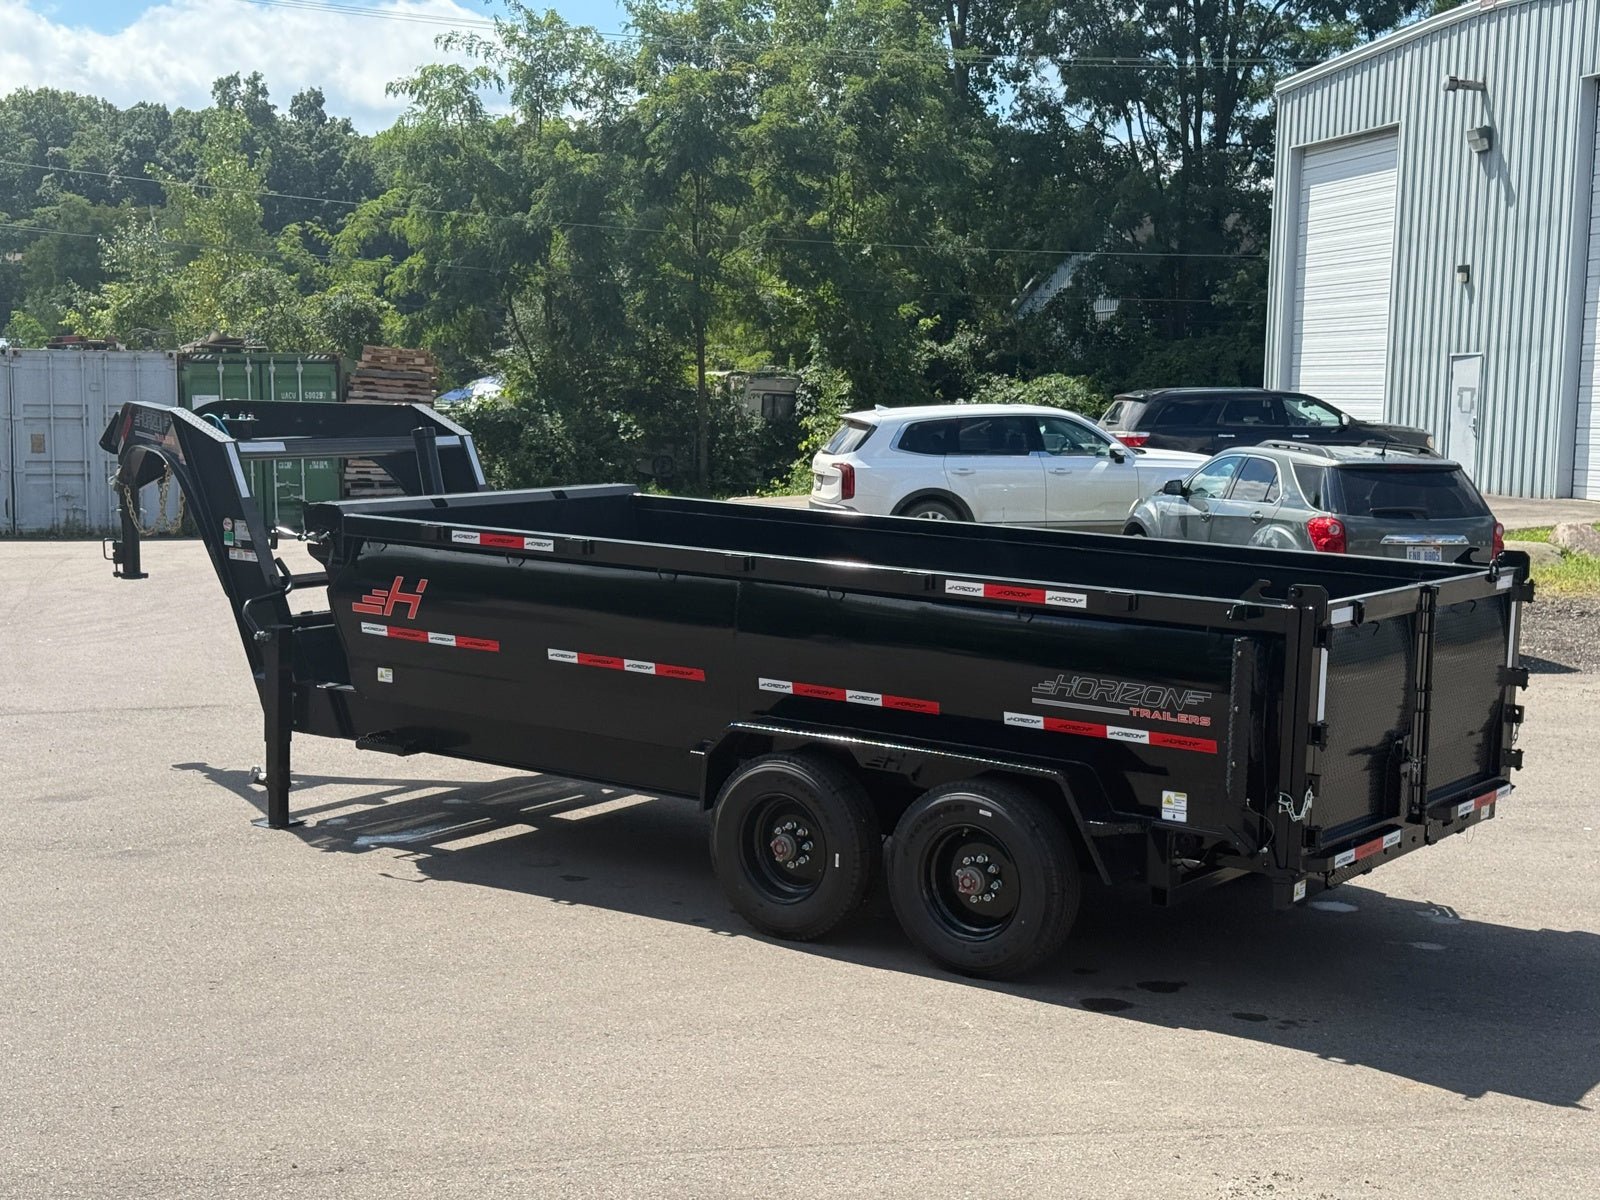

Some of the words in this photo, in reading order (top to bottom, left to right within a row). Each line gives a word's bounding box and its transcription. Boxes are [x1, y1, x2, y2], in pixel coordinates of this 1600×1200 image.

[948, 585, 982, 593] HORIZON
[1047, 594, 1084, 604] HORIZON
[1045, 674, 1194, 711] HORIZON
[1129, 706, 1211, 727] TRAILERS
[1007, 716, 1040, 725] HORIZON
[1109, 730, 1147, 740] HORIZON
